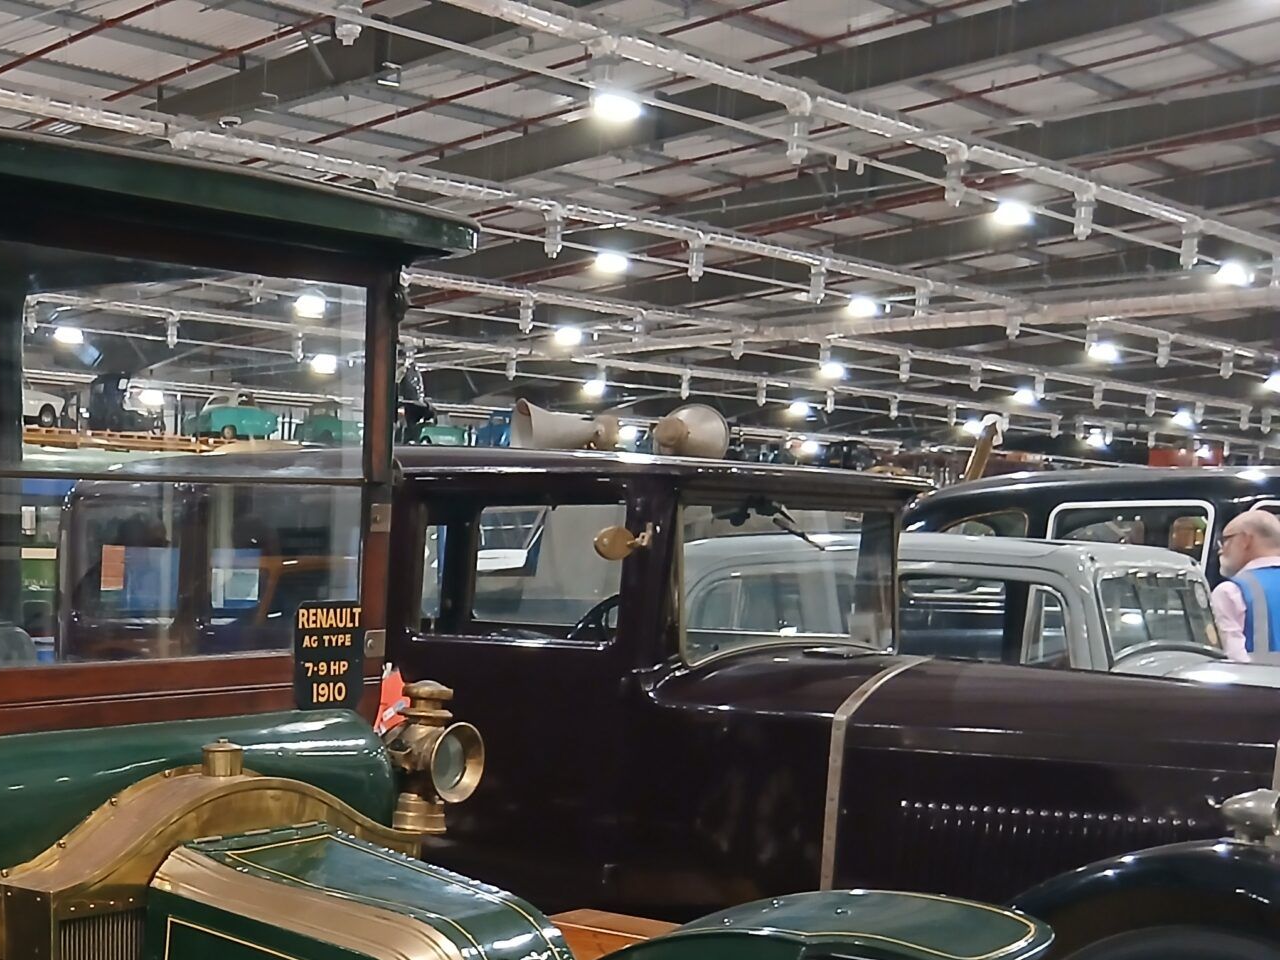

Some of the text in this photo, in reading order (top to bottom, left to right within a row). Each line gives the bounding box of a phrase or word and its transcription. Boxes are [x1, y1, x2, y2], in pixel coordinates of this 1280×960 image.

[298, 607, 361, 629] RENAULT
[302, 633, 352, 648] AG TYPE
[330, 660, 349, 676] HP
[312, 682, 347, 703] 1910
